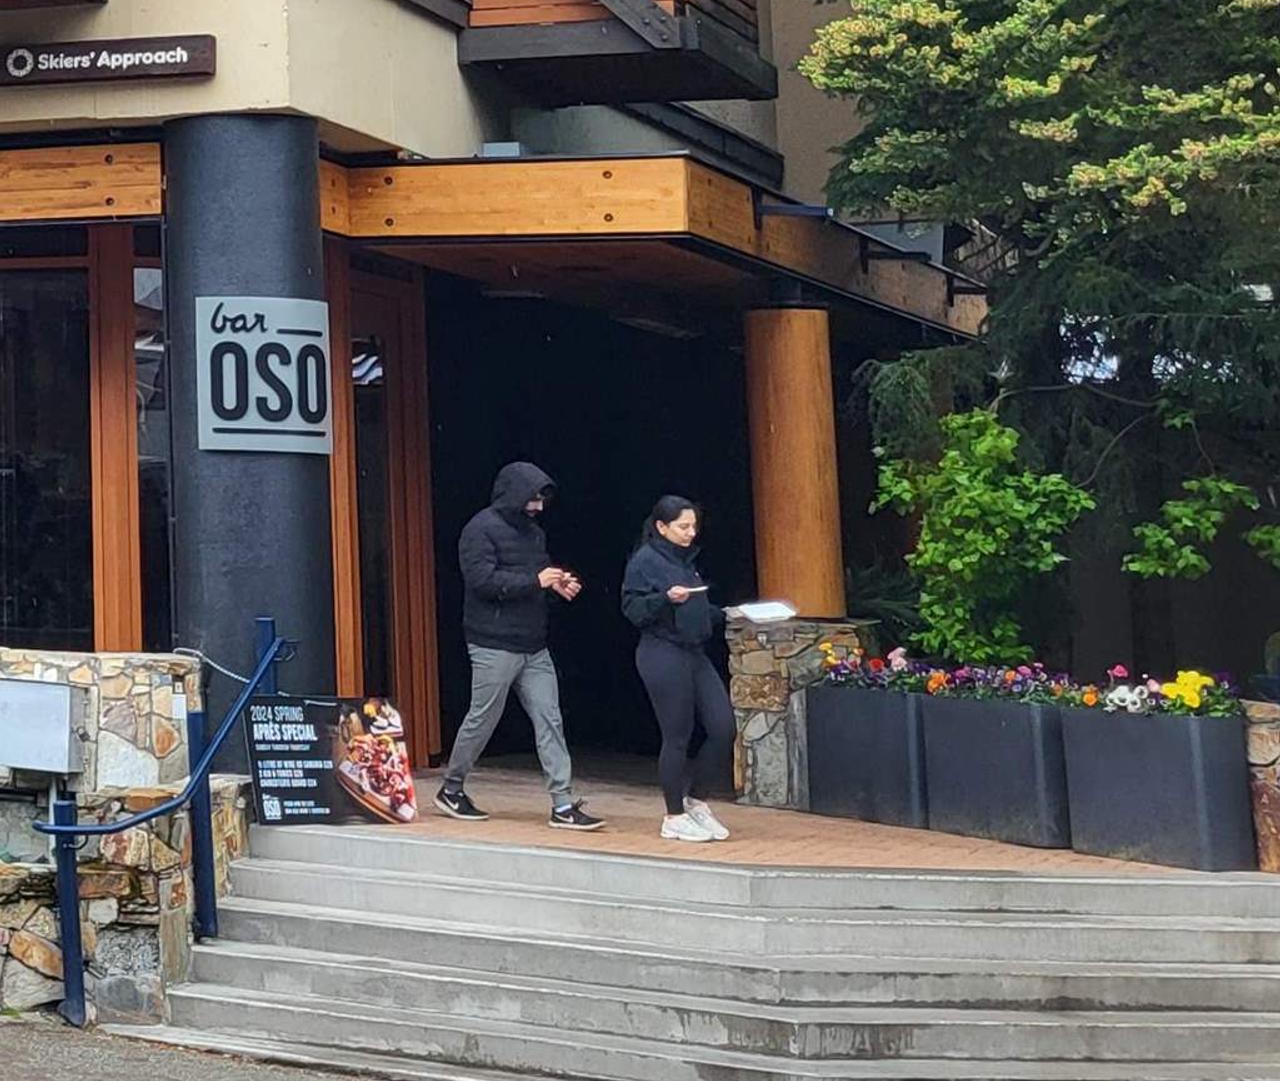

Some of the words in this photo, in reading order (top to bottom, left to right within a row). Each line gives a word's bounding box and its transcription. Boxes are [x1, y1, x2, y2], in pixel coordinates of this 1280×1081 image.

[37, 51, 96, 70] Skiers'
[96, 46, 188, 70] Approach
[210, 302, 268, 334] bar
[210, 341, 327, 424] OSO
[250, 705, 273, 721] 2024
[274, 706, 304, 722] SPRING
[281, 724, 319, 741] SPECIAL
